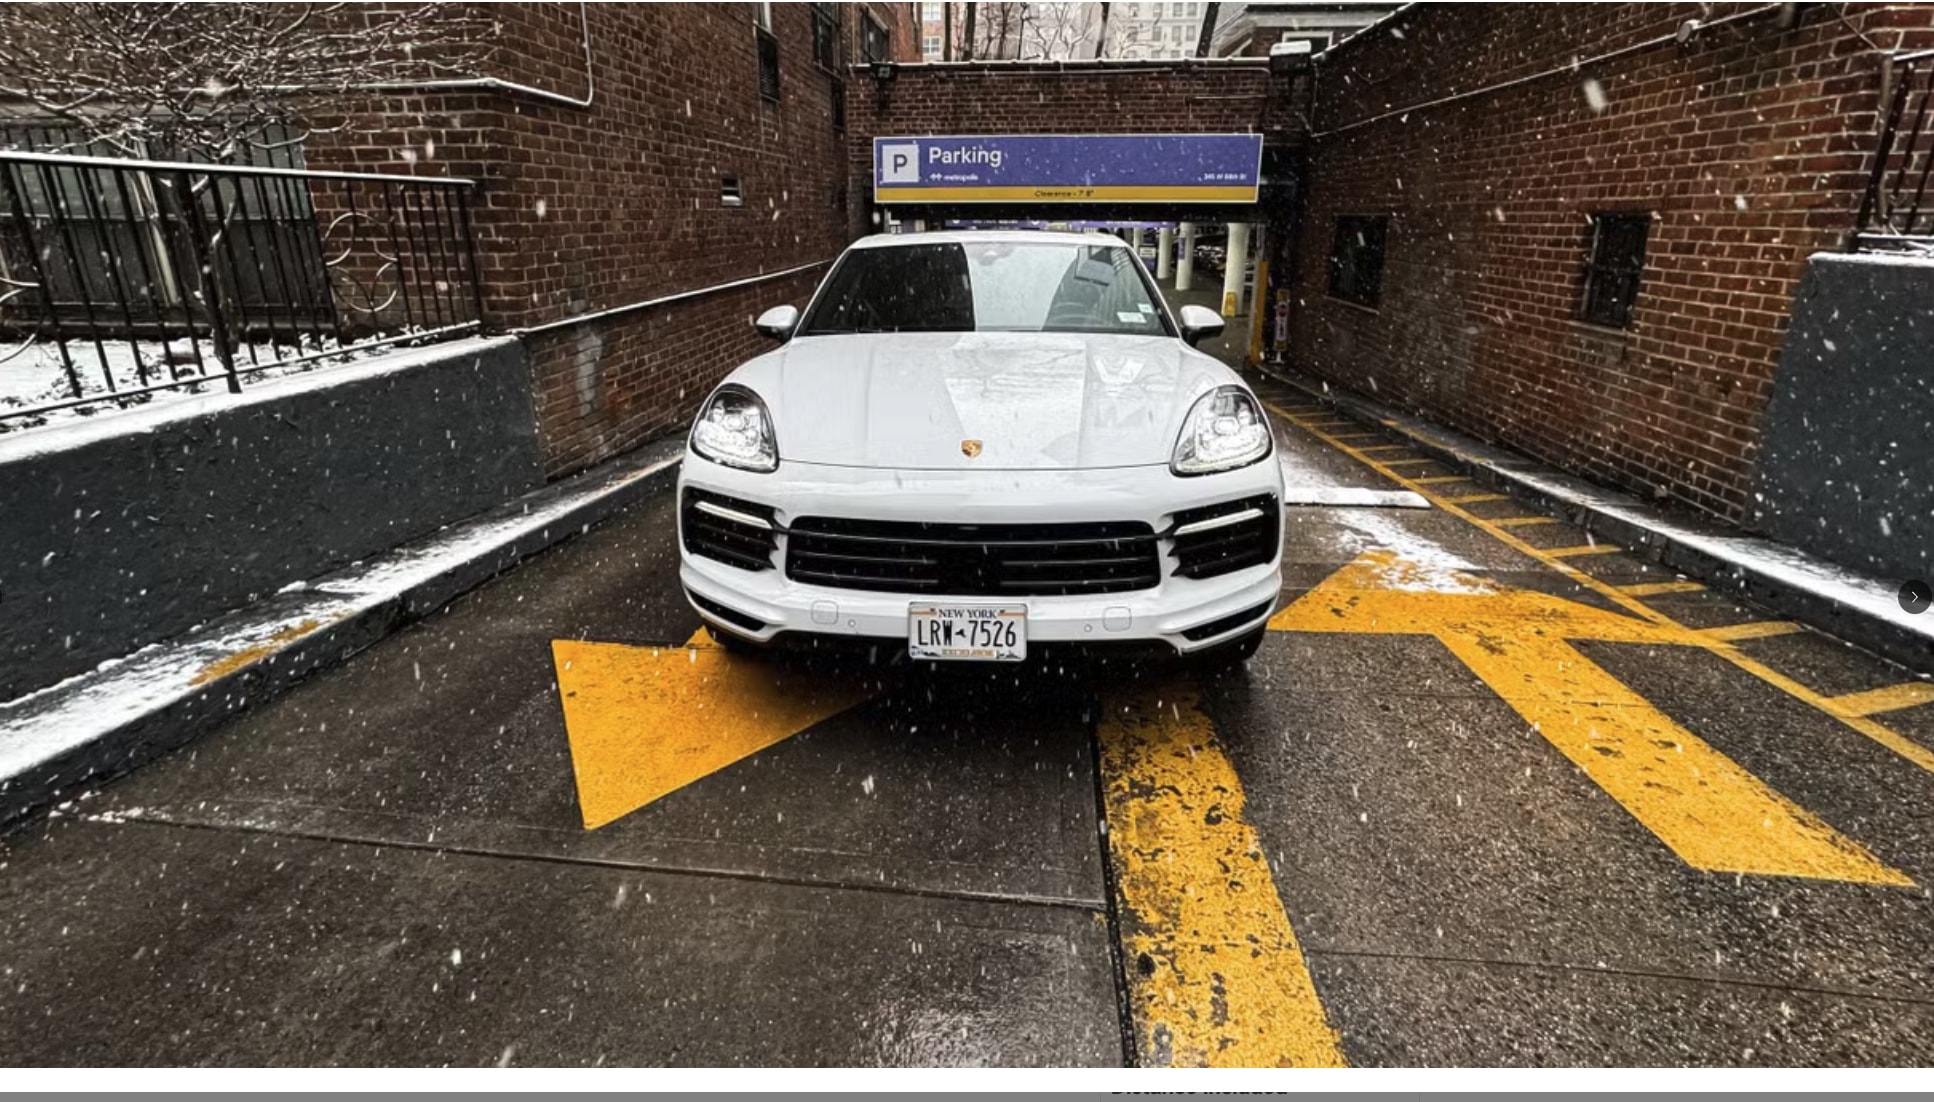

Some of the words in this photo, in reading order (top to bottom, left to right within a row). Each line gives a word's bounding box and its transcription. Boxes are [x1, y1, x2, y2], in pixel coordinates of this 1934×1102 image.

[893, 154, 908, 174] P
[929, 146, 1001, 168] Parking
[1034, 189, 1071, 198] Clearance
[939, 609, 964, 618] NEW
[967, 609, 996, 619] YORK
[917, 619, 953, 646] LRW
[968, 620, 1016, 647] 7526
